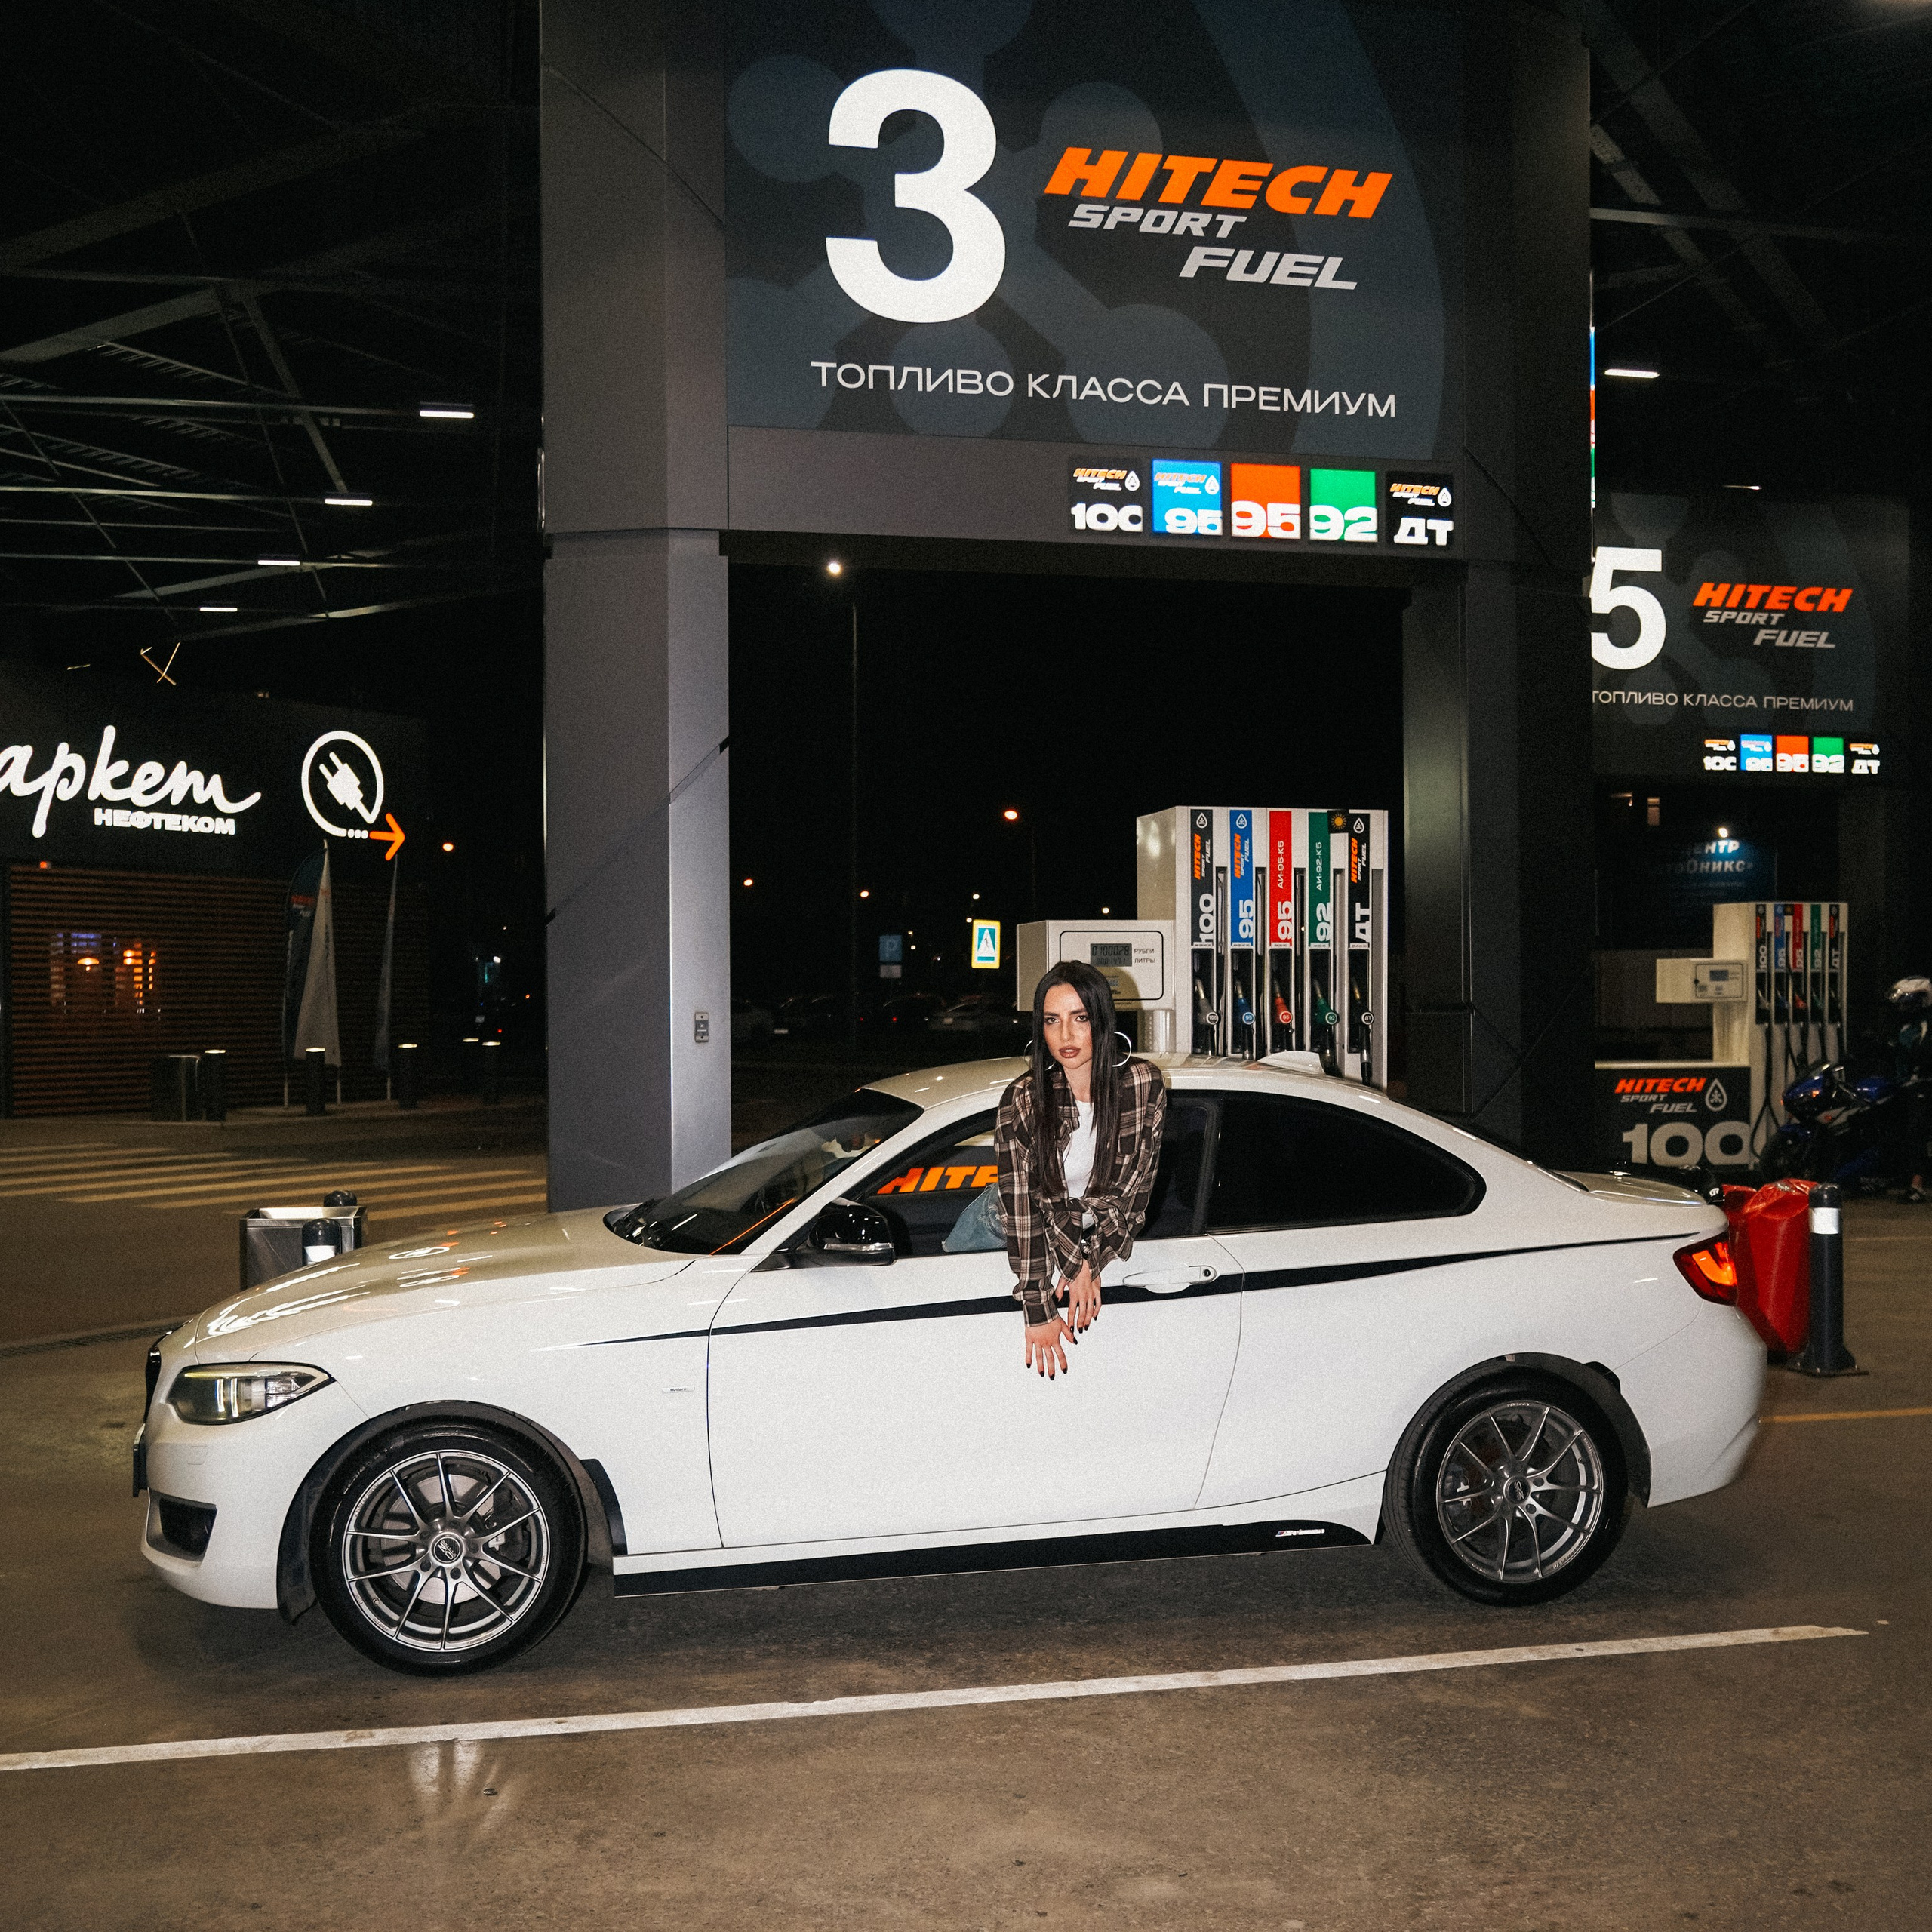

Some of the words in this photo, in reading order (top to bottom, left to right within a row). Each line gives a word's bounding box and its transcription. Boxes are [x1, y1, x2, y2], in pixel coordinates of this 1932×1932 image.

[826, 69, 1006, 324] 3
[1044, 147, 1393, 219] HITECH
[1068, 203, 1247, 238] SPORT
[1179, 245, 1358, 291] FUEL
[811, 361, 1014, 398] ТОПЛИВО
[1028, 372, 1190, 407] КЛАССА
[1204, 383, 1396, 418] ПРЕМИУМ
[1072, 467, 1128, 480] HITECH
[1389, 482, 1441, 496] HITECH
[1164, 507, 1223, 536] 95
[1231, 500, 1301, 540] 95
[1309, 504, 1378, 543] 92
[1393, 517, 1454, 546] ДТ
[1589, 546, 1666, 670] 5
[1692, 582, 1854, 613] HITECH
[1703, 610, 1785, 626] SPORT
[1753, 629, 1836, 649] FUEL
[1684, 694, 1758, 709] КЛАССА
[1764, 697, 1854, 712] ПРЕМИУМ
[1812, 753, 1845, 773] 92
[1851, 759, 1880, 774] ДТ
[94, 808, 235, 835] НЕФТЕКОМ
[1199, 893, 1214, 943] 100
[1238, 899, 1254, 939] 95
[1277, 900, 1293, 940] 95
[1315, 902, 1331, 942] 92
[1355, 903, 1371, 943] ДТ
[1614, 1078, 1707, 1094] HITECH
[1620, 1094, 1668, 1103] SPORT
[1650, 1103, 1697, 1114] FUEL
[1623, 1121, 1751, 1167] 100
